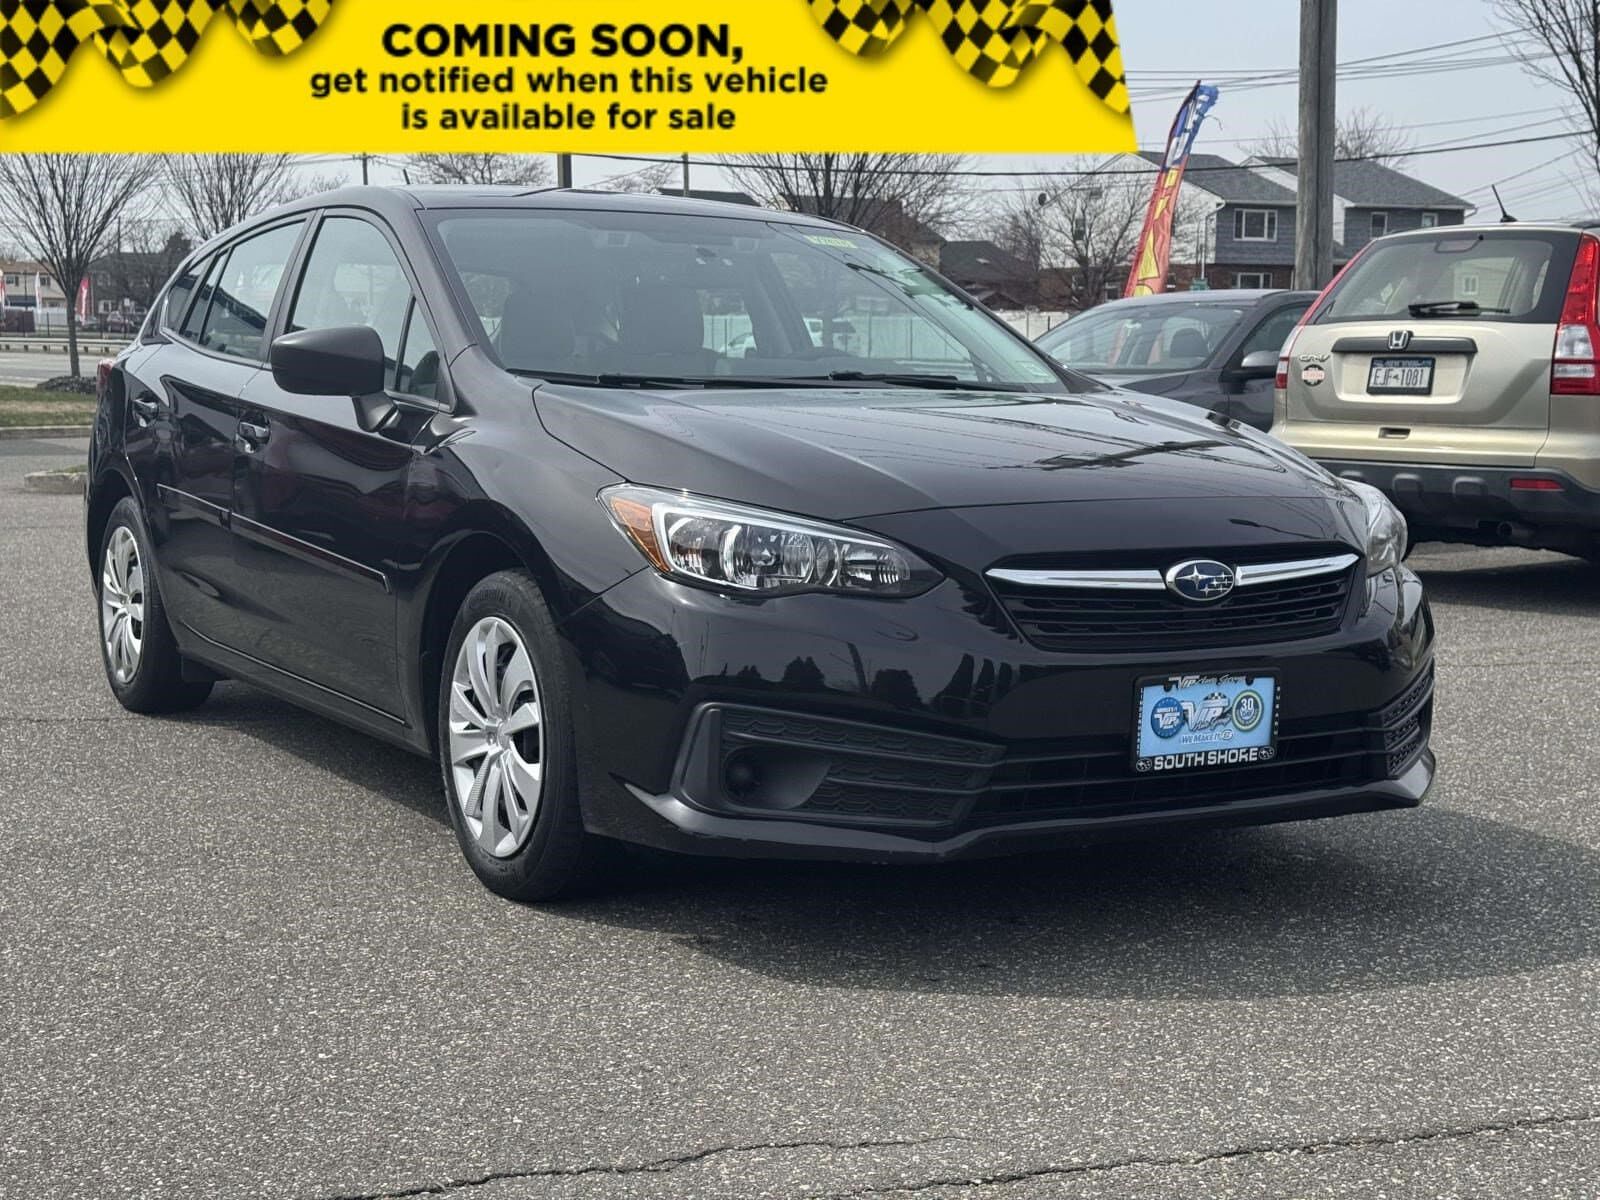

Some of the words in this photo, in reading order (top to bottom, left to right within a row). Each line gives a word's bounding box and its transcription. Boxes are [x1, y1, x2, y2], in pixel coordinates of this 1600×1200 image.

[1240, 698, 1254, 711] 30
[1154, 752, 1204, 771] SOUTH
[1207, 748, 1259, 765] SHORE
